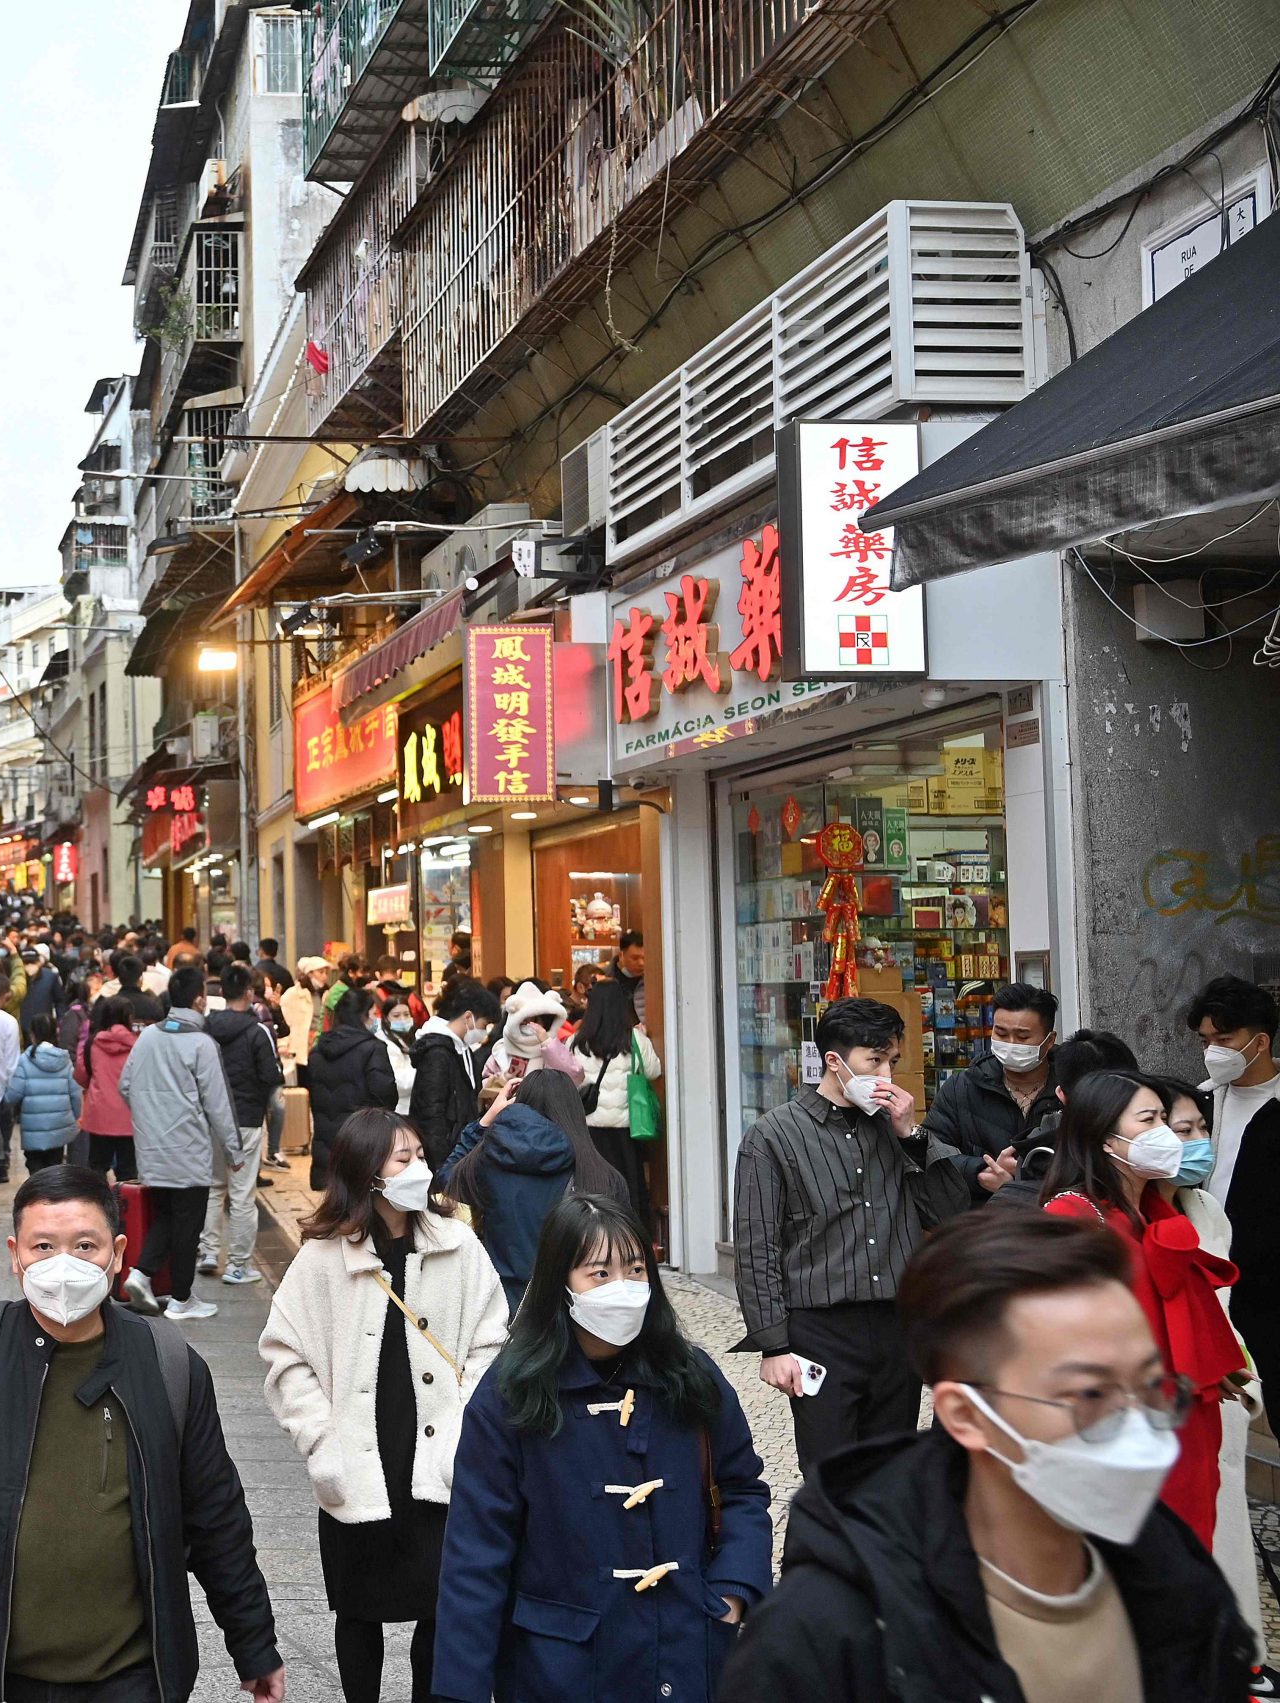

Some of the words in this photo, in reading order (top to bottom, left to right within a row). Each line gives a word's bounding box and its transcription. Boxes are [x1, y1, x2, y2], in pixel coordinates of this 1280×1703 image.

[1181, 245, 1197, 264] RUA
[829, 436, 895, 606] 信誠藥房
[487, 634, 538, 796] 鳳城明發手信
[625, 713, 715, 754] FARMÁCIA
[723, 689, 781, 721] SEON
[831, 828, 854, 853] 福
[805, 1044, 821, 1058] 進店
